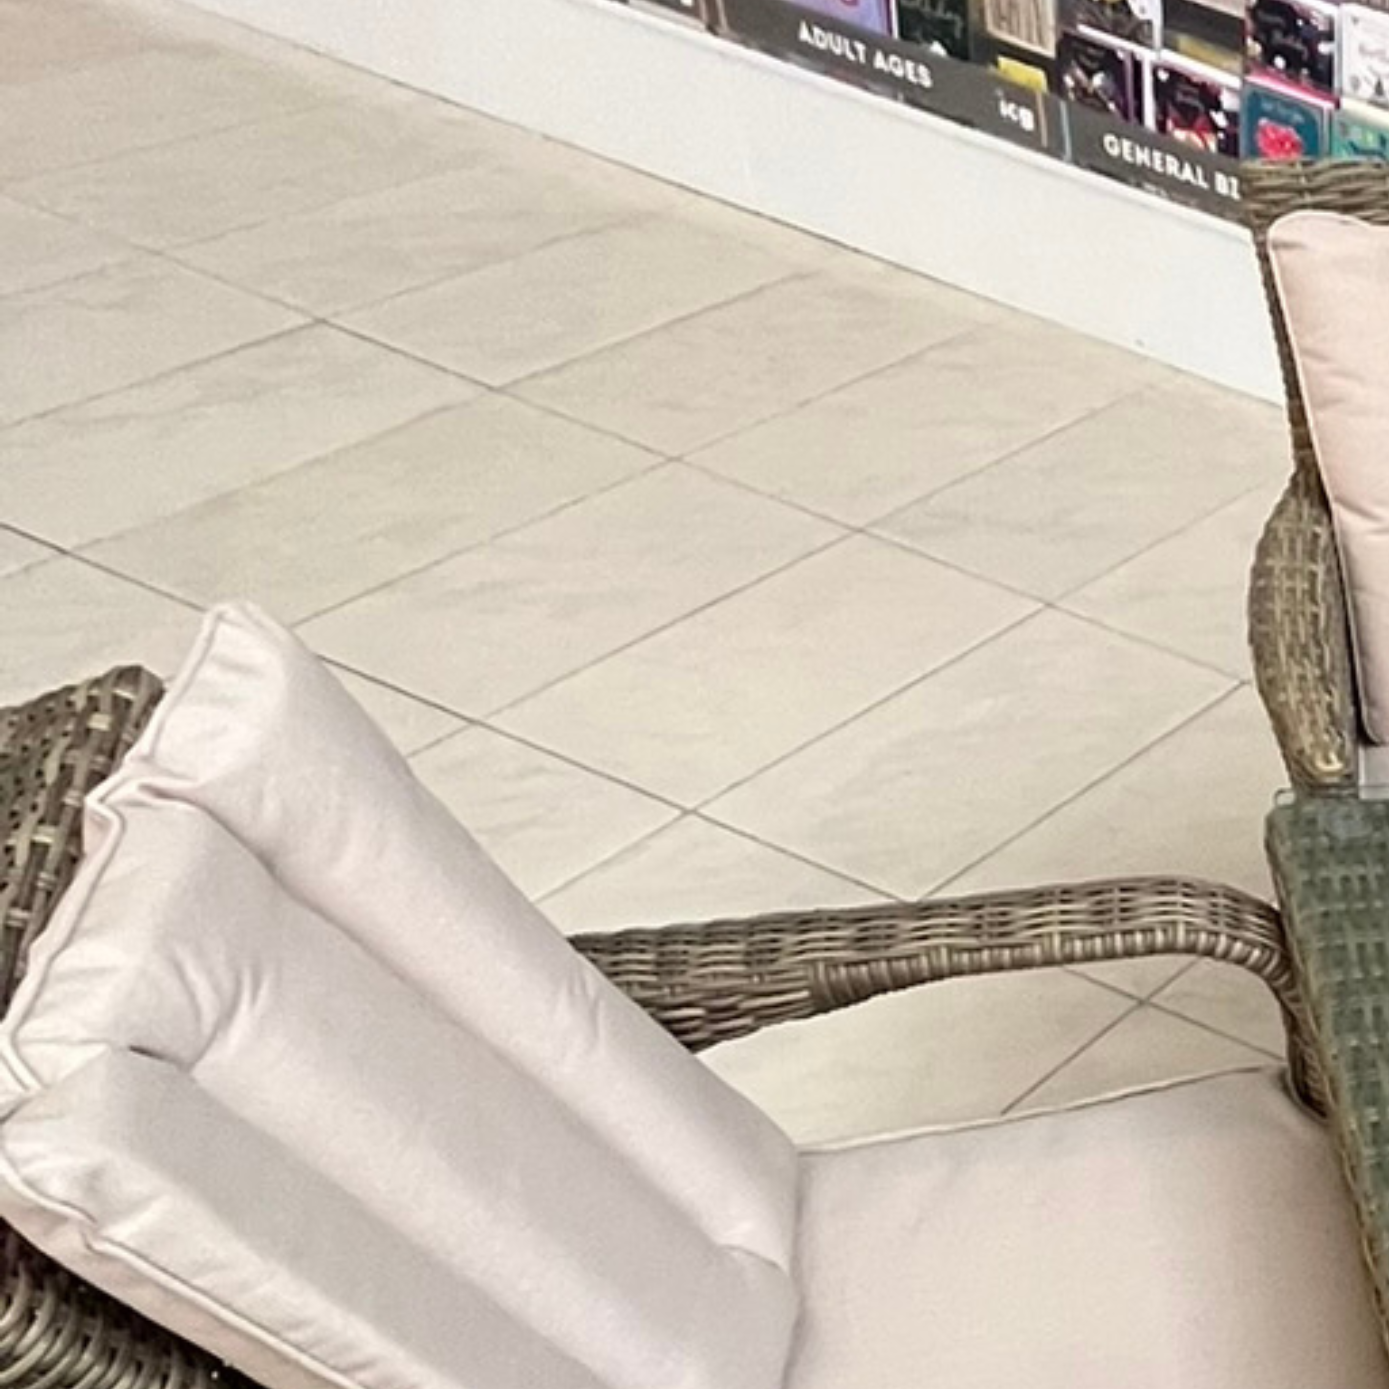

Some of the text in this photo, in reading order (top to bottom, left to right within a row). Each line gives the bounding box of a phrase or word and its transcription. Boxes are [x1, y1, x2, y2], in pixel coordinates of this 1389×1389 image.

[798, 20, 868, 64] ADULT
[872, 49, 933, 89] AGES
[1102, 133, 1210, 190] GENERAL
